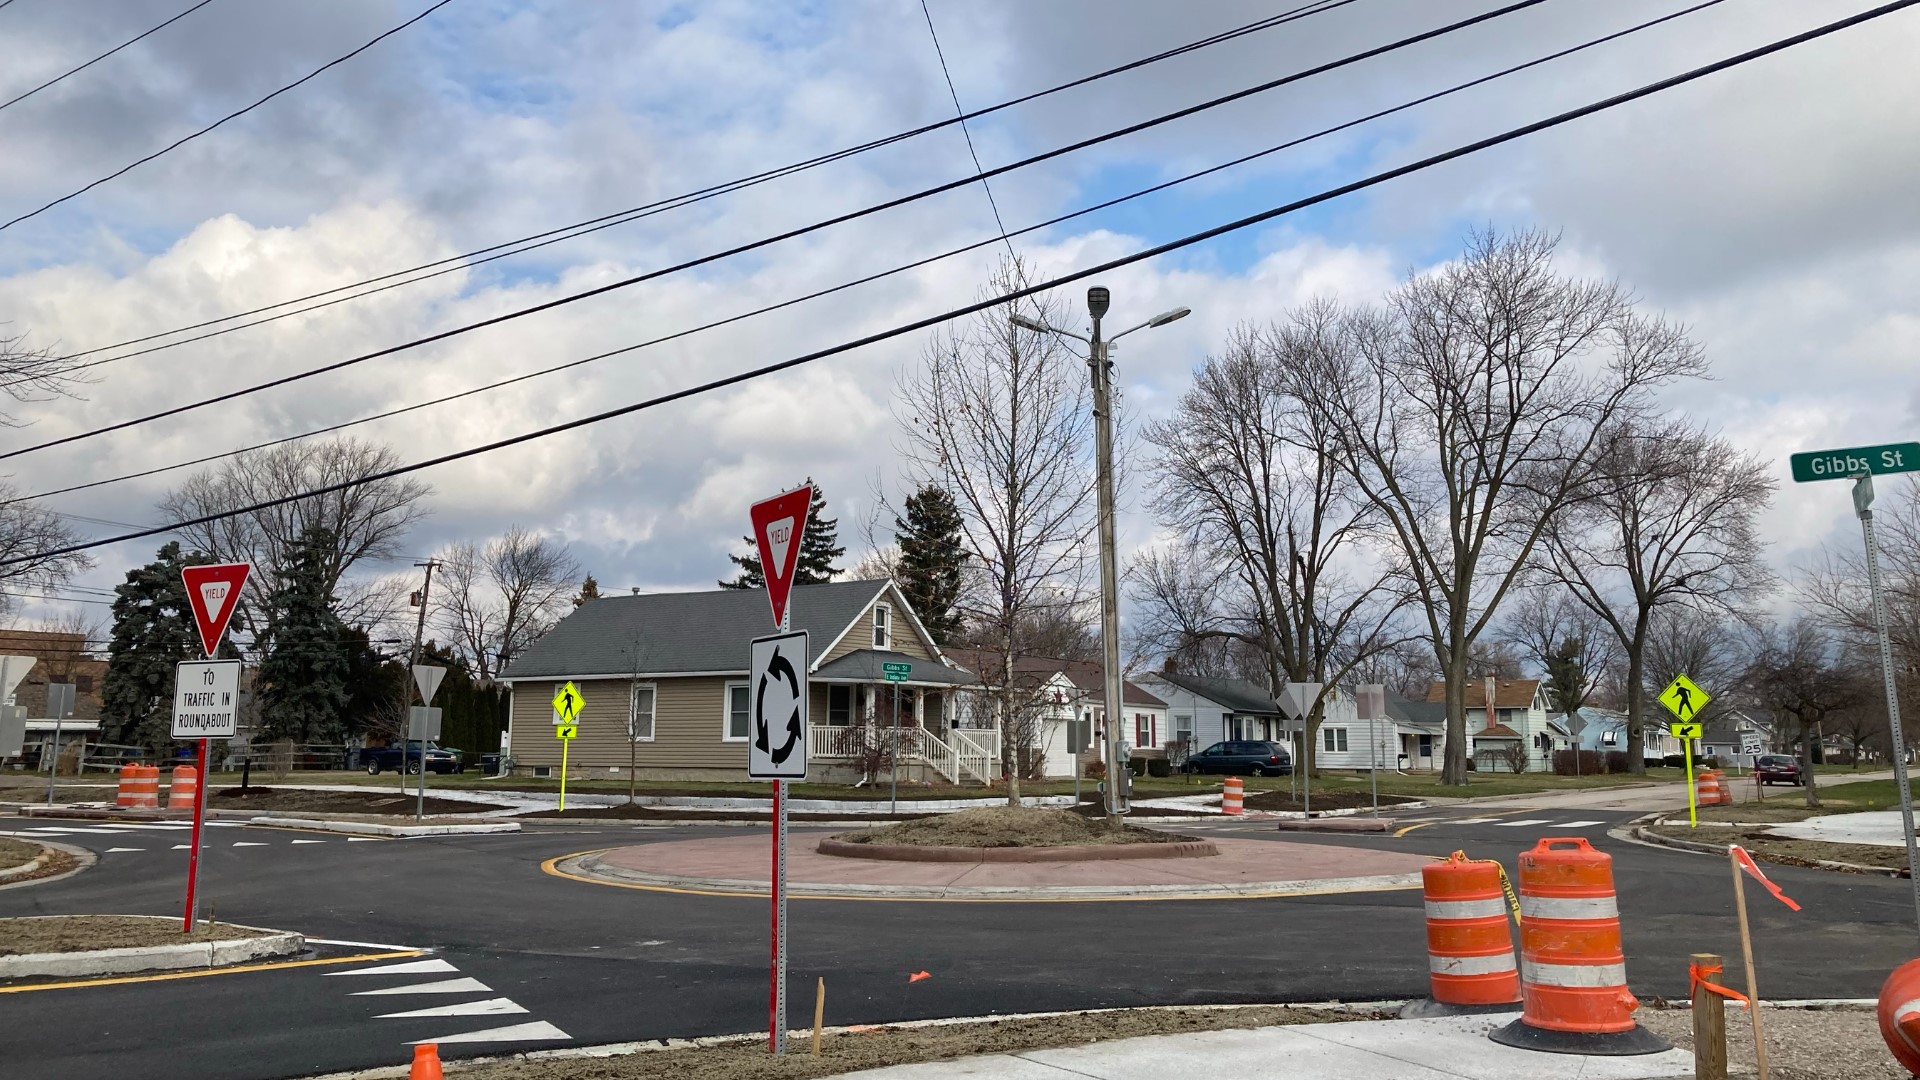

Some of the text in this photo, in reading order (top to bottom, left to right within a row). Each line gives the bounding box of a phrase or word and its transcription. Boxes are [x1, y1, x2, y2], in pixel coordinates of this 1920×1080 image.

[1811, 450, 1904, 475] Gibbs St
[771, 526, 789, 546] YIELD
[204, 587, 226, 600] YIELD
[203, 670, 215, 686] TO
[183, 691, 231, 707] TRAFFIC IN
[178, 713, 231, 729] ROUNDABOUT
[1744, 744, 1762, 755] 25
